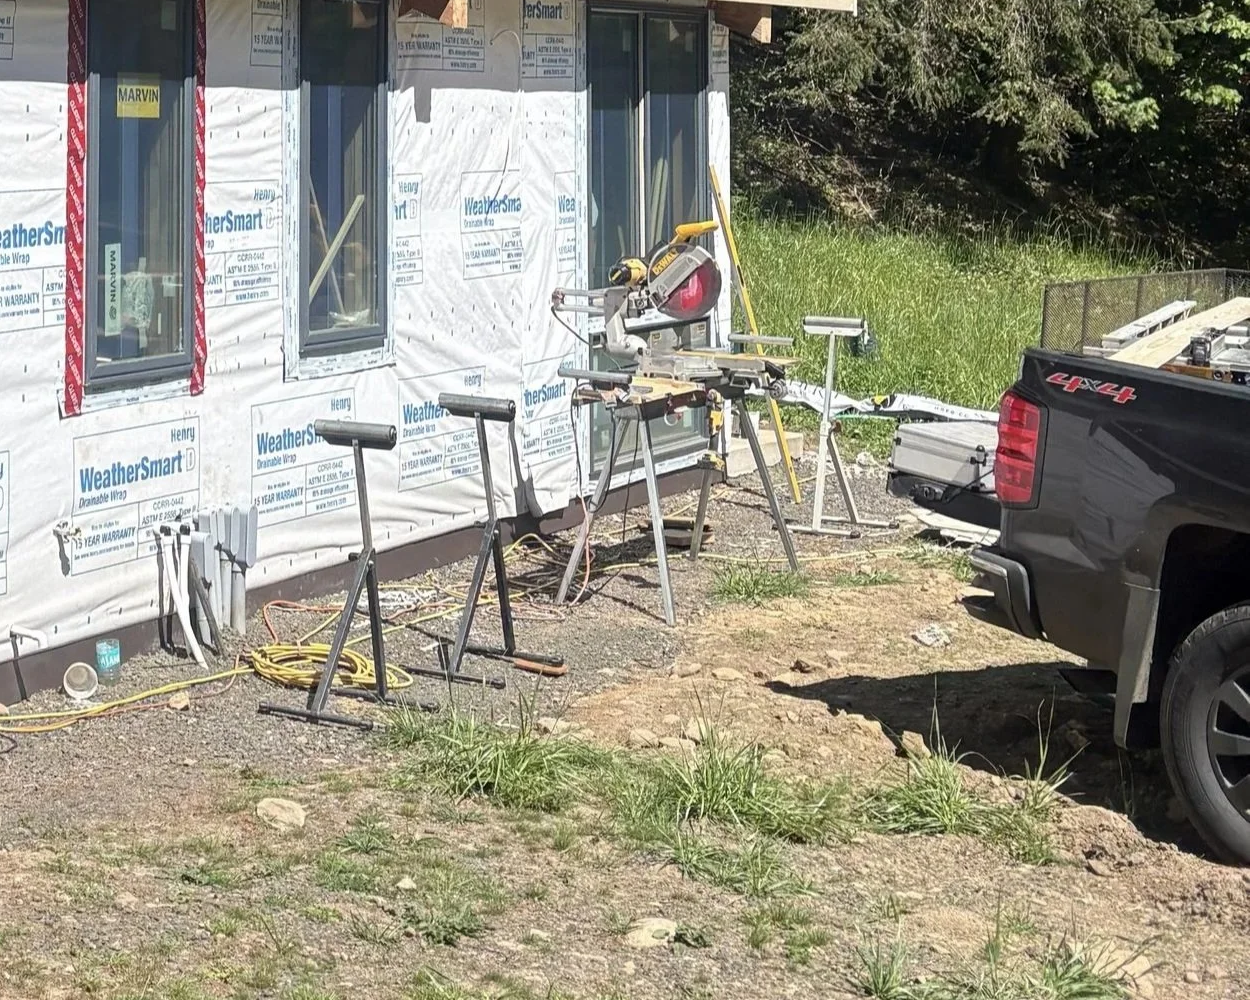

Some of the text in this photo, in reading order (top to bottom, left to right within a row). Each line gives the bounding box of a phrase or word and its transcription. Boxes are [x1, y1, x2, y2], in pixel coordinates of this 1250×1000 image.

[526, 0, 562, 19] erSmart
[119, 88, 158, 102] MARVIN
[205, 209, 262, 234] herSmart
[12, 252, 30, 265] Wrap
[45, 283, 63, 292] ASTM
[4, 292, 40, 307] WARRANTY
[331, 397, 351, 411] Henry
[403, 400, 448, 424] Weather
[171, 426, 195, 442] Henry
[257, 423, 322, 455] WeatherS
[80, 450, 183, 493] WeatherSmart
[79, 490, 127, 509] Drainable Wrap
[84, 527, 137, 549] YEAR WARRANTY
